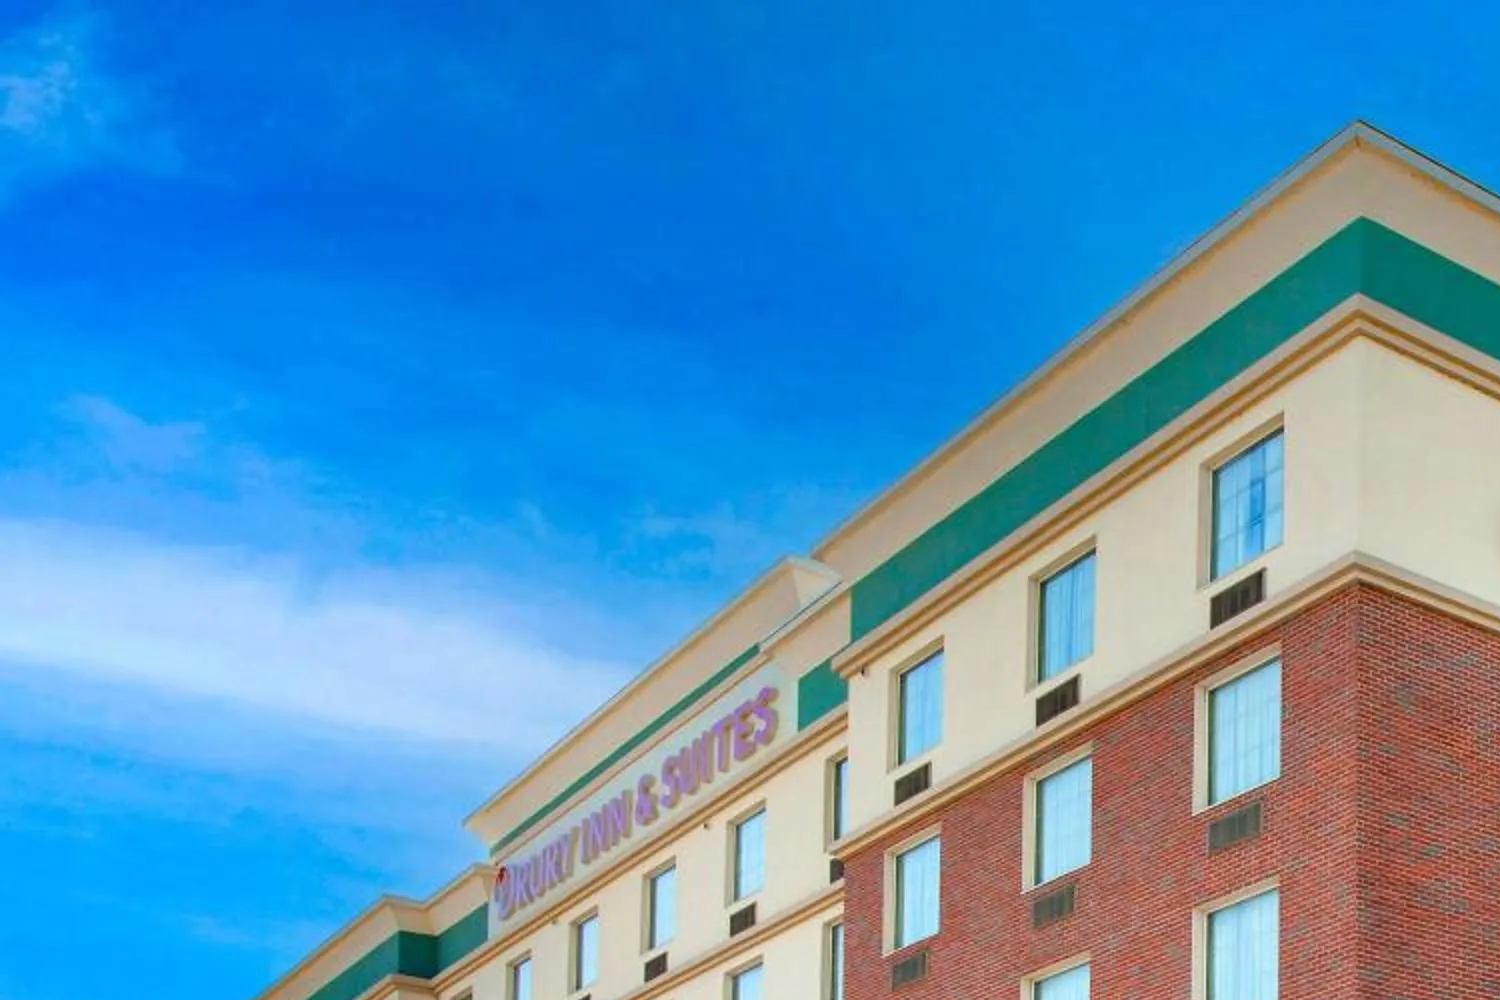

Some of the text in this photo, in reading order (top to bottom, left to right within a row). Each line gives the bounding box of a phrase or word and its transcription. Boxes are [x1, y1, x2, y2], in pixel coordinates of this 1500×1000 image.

[493, 686, 780, 920] DRURY INN & SUITES
